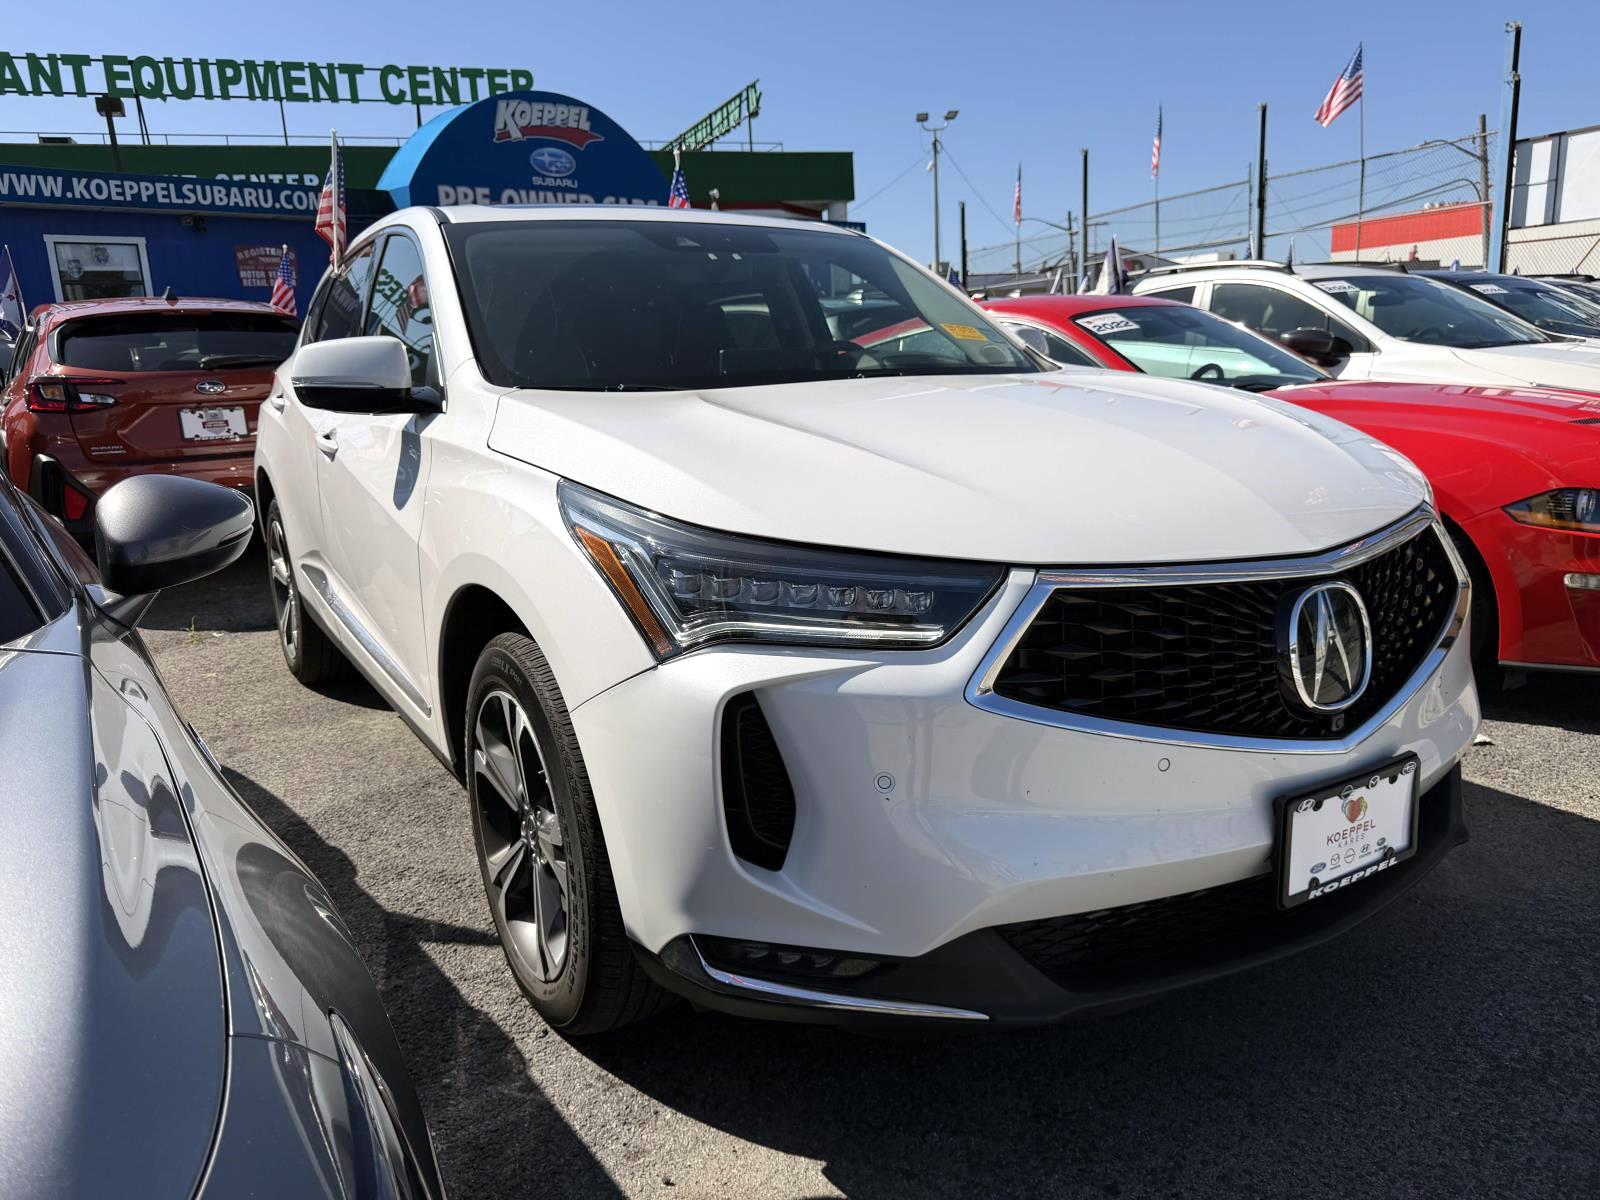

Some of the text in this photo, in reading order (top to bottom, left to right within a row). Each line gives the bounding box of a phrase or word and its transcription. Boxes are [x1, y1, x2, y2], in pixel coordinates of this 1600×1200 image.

[0, 51, 534, 105] ANT EQUIPMENT CENTER
[495, 99, 591, 140] KOEPPEL
[532, 176, 579, 188] SUBARU
[236, 247, 296, 260] REGISTERD
[1092, 320, 1134, 332] 2022
[1326, 819, 1376, 846] KOEPPEL
[1308, 856, 1399, 900] KOEPPEL
